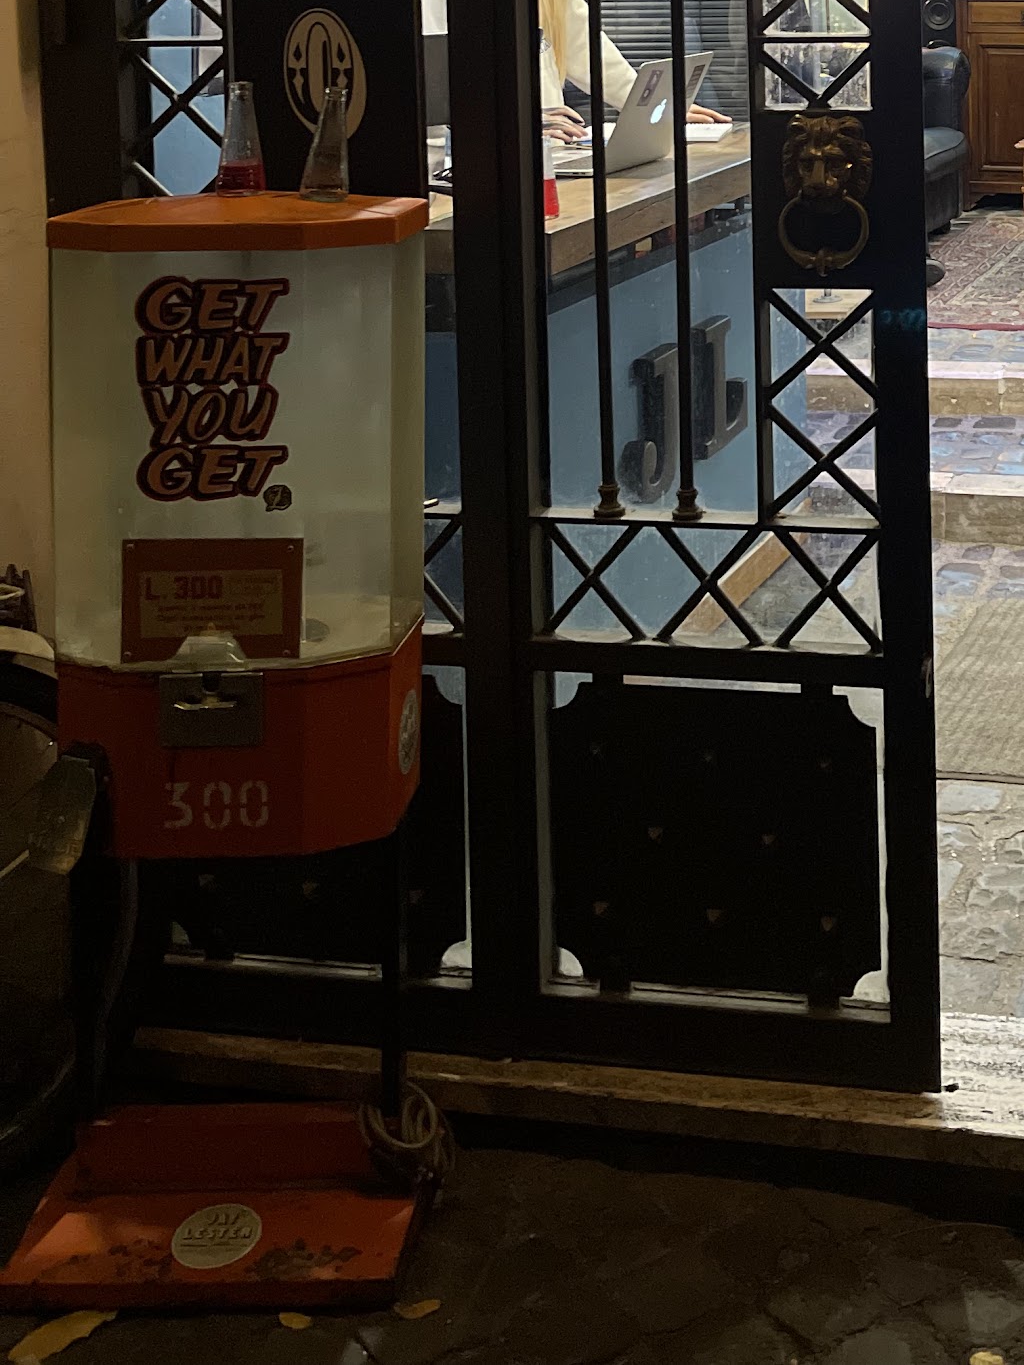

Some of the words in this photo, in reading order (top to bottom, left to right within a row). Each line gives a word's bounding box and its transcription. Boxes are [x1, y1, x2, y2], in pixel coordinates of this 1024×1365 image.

[136, 276, 290, 333] GET
[136, 333, 290, 387] WHAT
[142, 385, 279, 447] YOU
[136, 446, 289, 501] GET
[173, 575, 224, 601] 300
[163, 780, 270, 830] 300
